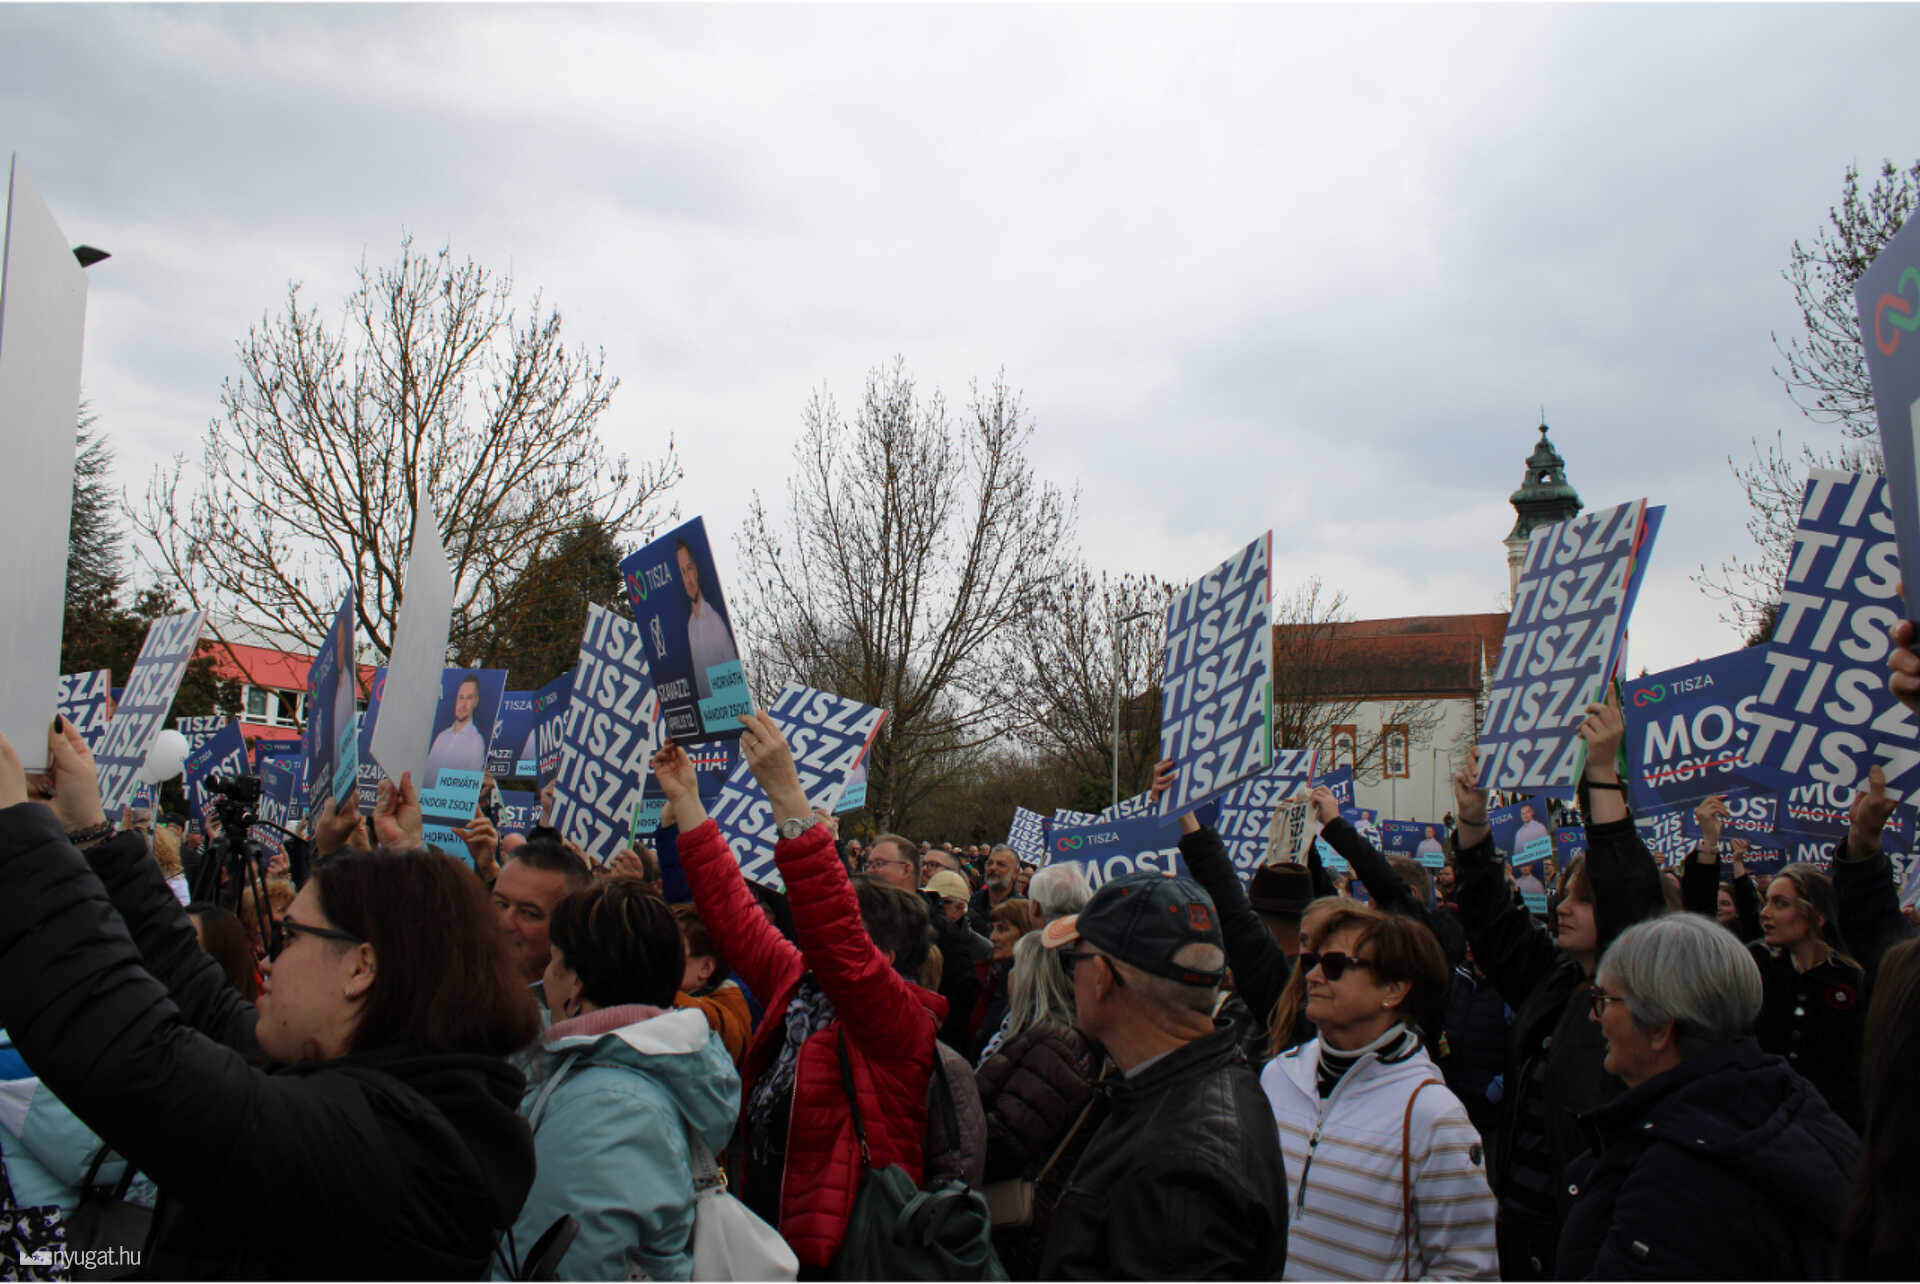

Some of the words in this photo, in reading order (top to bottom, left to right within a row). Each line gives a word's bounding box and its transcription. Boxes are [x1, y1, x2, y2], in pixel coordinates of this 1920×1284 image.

[1522, 500, 1638, 574] TISZA
[1786, 527, 1901, 600] TIS
[645, 562, 672, 591] TISZA
[1170, 536, 1267, 632] TISZA
[1508, 555, 1629, 628] TISZA
[143, 611, 204, 658] TISZA
[582, 601, 649, 677] TISZ
[1166, 577, 1267, 677] TISZA
[1496, 613, 1618, 681] TISZA
[1773, 588, 1900, 663] TIS
[122, 662, 190, 707] TISZA
[574, 648, 658, 726] TISZA
[712, 668, 744, 689] HORVÁTH
[1163, 623, 1268, 721] TISZA
[1671, 673, 1715, 695] TISZA
[94, 713, 166, 758] TISZA
[504, 700, 533, 712] TISZA
[565, 695, 651, 779] TISZA
[770, 681, 882, 737] TISZA
[1161, 676, 1266, 760] TISZA
[1481, 673, 1599, 737] TISZA
[440, 775, 479, 790] HORVÁTH
[556, 741, 641, 831] TISZA
[1160, 722, 1265, 816] TISZA
[1476, 734, 1585, 788] TISZA
[1642, 754, 1711, 789] VAGY
[450, 800, 476, 813] ZSOLT
[1088, 832, 1120, 845] TISZA
[1787, 803, 1835, 823] VAGY
